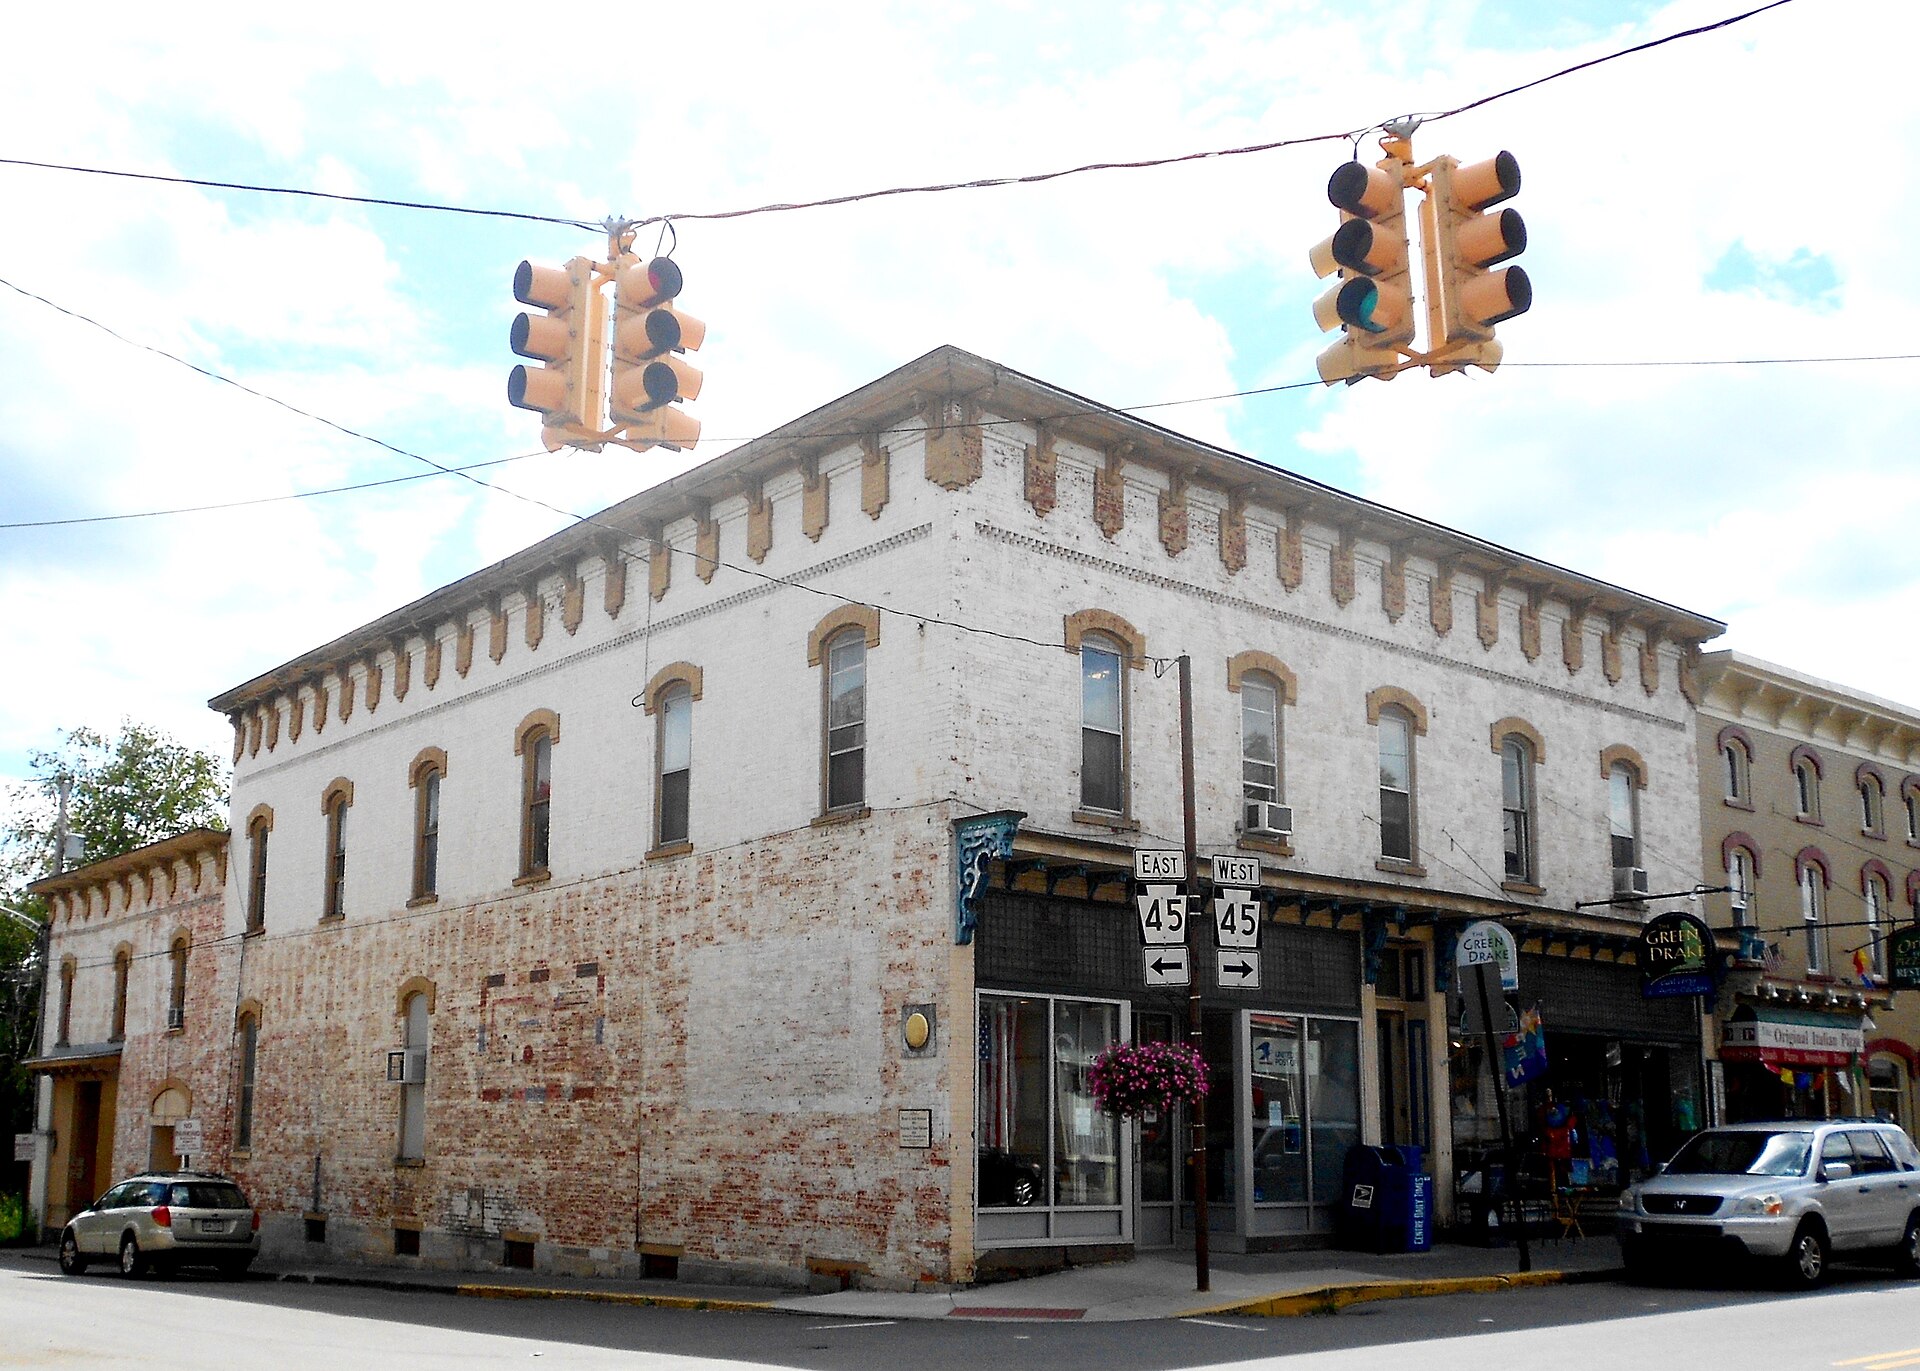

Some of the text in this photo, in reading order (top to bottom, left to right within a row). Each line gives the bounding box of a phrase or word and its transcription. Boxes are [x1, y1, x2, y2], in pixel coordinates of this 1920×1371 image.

[1142, 854, 1178, 874] EAST
[1218, 860, 1255, 881] WEST
[1145, 898, 1183, 932] 45
[1220, 903, 1256, 936] 45
[1463, 937, 1504, 950] GREEN
[1645, 928, 1699, 945] GREEN
[1469, 950, 1509, 962] DRAKE
[1650, 944, 1706, 962] DRAKE
[1774, 1028, 1809, 1045] Original
[1812, 1031, 1838, 1046] Italian
[1414, 1177, 1424, 1198] TIMES
